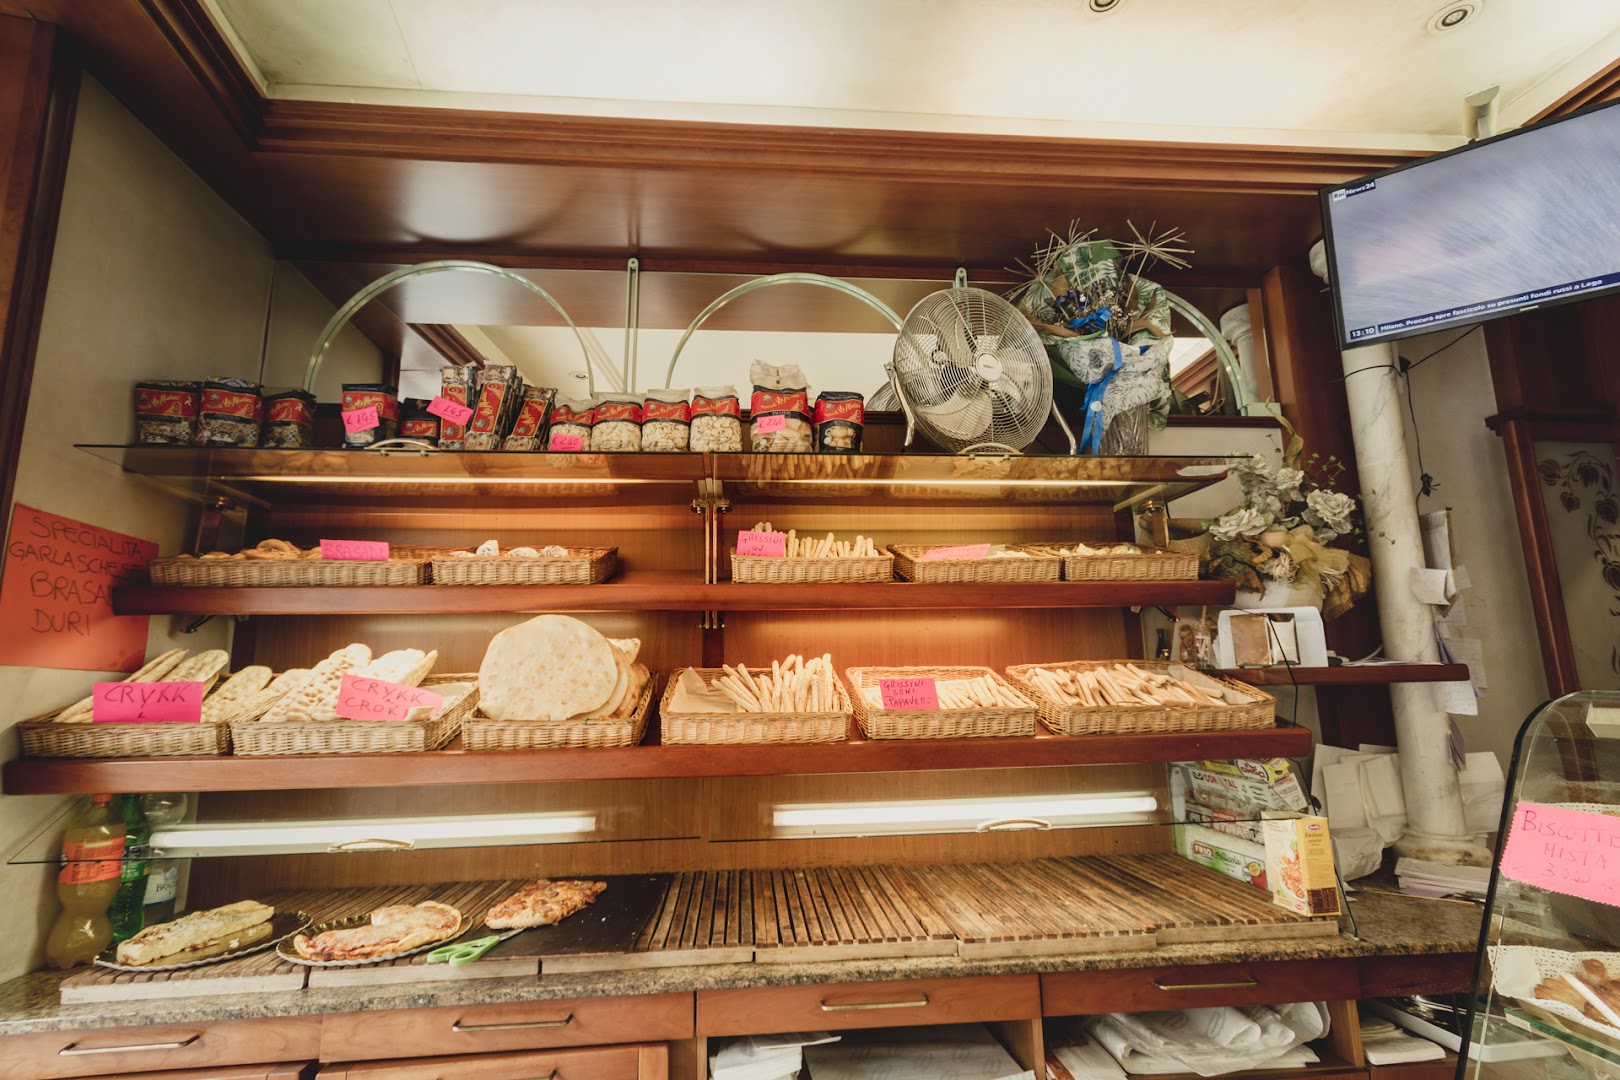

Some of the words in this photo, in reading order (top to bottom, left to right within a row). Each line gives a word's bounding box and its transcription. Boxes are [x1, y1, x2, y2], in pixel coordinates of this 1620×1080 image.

[1351, 327, 1375, 338] 13:10
[1380, 322, 1405, 331] Milano.
[1406, 316, 1434, 326] Procura
[1434, 312, 1451, 320] apre
[1452, 305, 1486, 316] fascicolo
[1497, 294, 1529, 307] presunti
[1530, 289, 1552, 299] fondi
[1553, 285, 1572, 294] russi
[1581, 280, 1603, 288] Lega
[741, 533, 782, 544] GRISSINI
[32, 608, 91, 636] DURI
[104, 684, 192, 709] CRYKK
[351, 679, 425, 704] CRYKK
[883, 680, 924, 691] GRISSINI
[1194, 844, 1213, 856] FRIO
